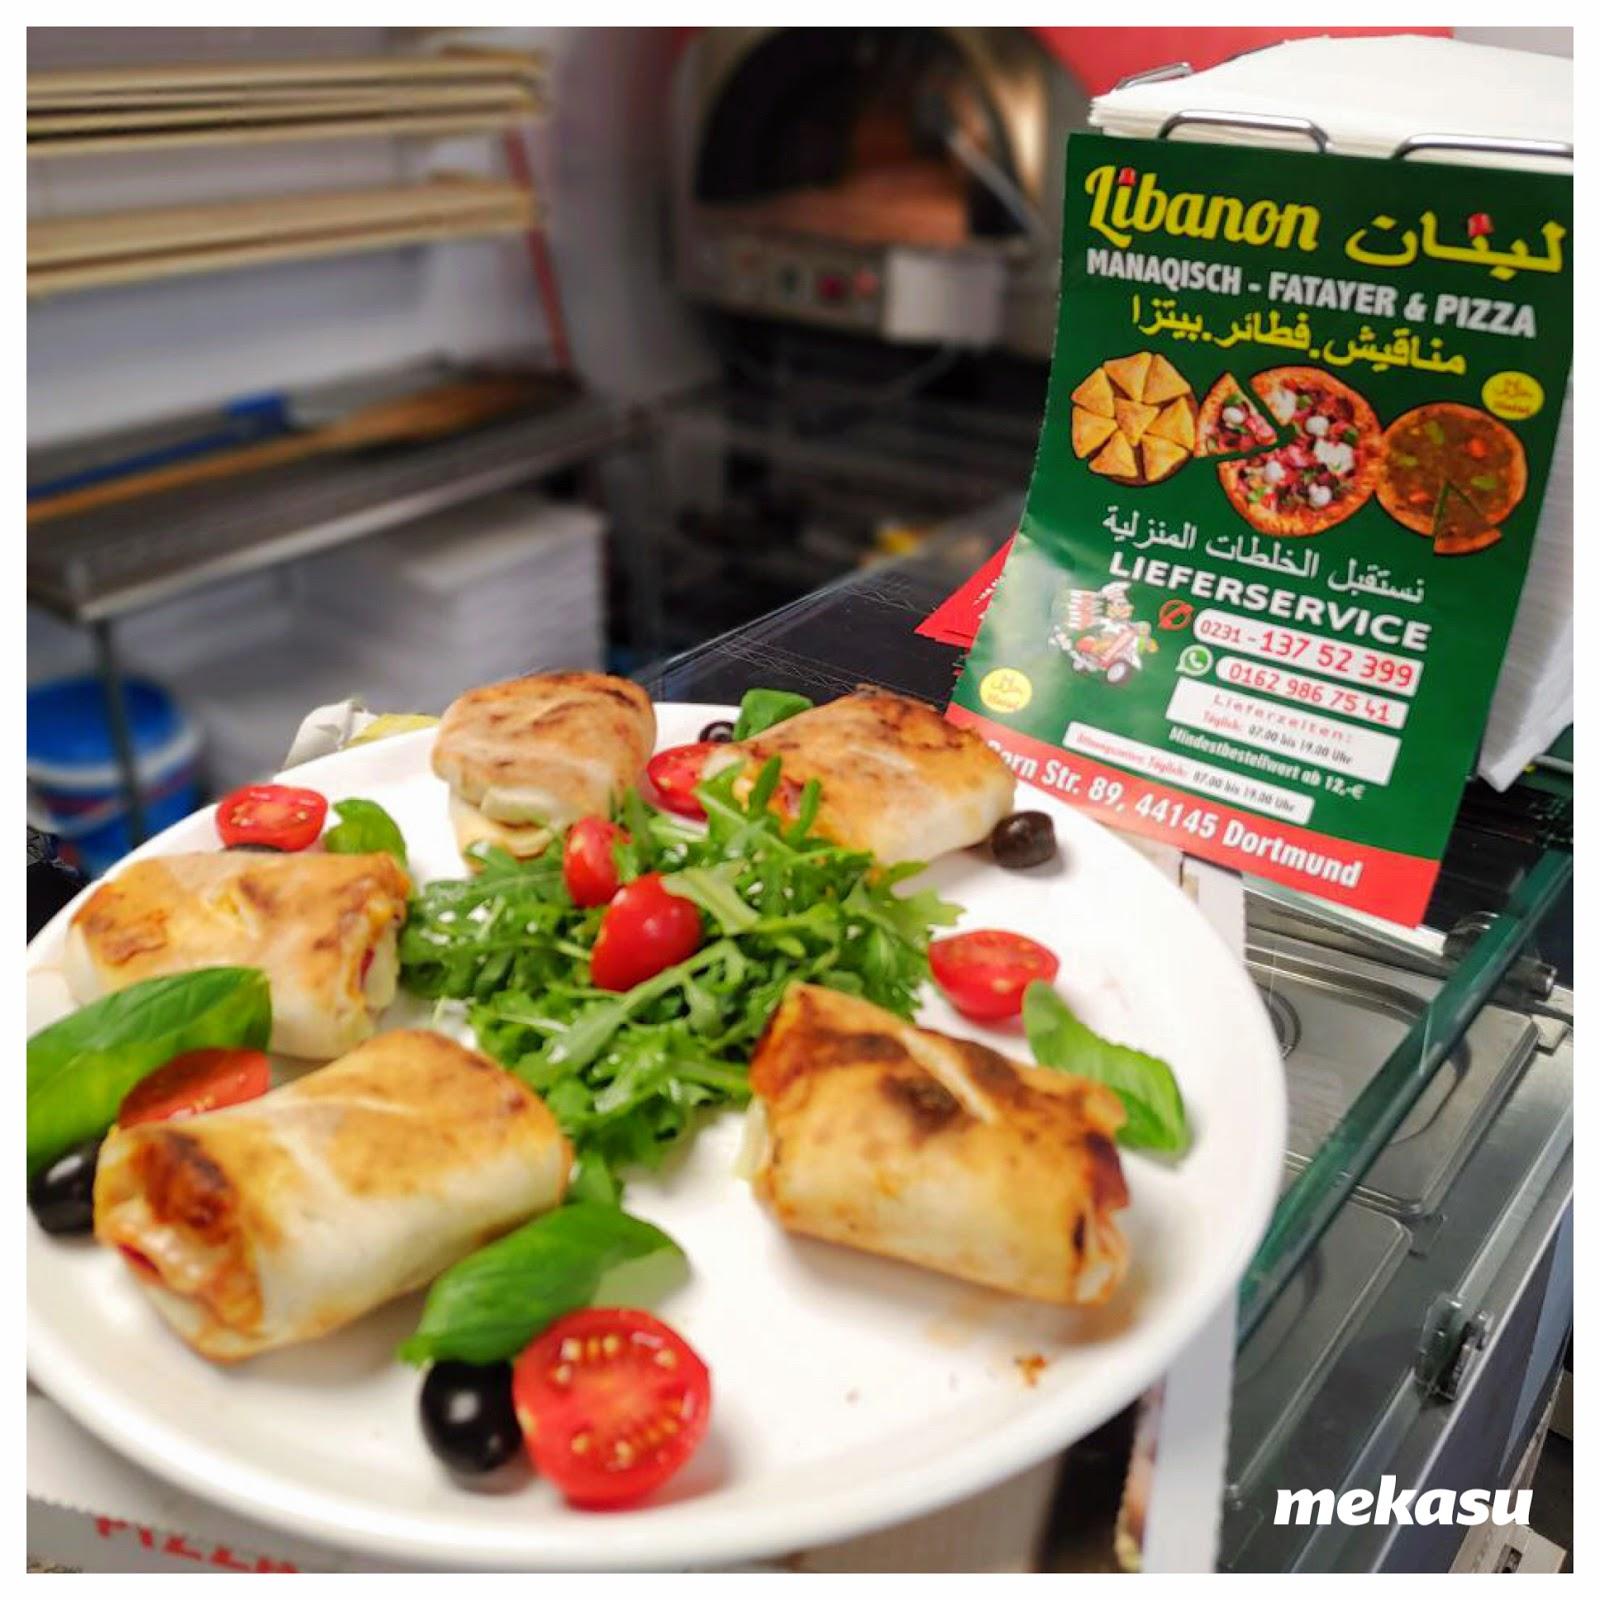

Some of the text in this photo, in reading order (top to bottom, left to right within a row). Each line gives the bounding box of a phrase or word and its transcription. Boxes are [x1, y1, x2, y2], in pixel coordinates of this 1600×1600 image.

[1085, 165, 1320, 251] Libanon
[1345, 210, 1566, 280] لبنان
[1086, 247, 1242, 296] MANAQISCH
[1268, 271, 1398, 318] FATAYER
[1403, 292, 1428, 322] &
[1434, 294, 1536, 339] PIZZA
[1109, 551, 1432, 651] LIEFERSERVICE
[1327, 558, 1425, 604] نستقبل
[1200, 619, 1241, 643] 0231
[1260, 630, 1310, 660] 137
[1317, 644, 1353, 672] 52
[1360, 655, 1414, 687] 399
[1229, 662, 1389, 722] 0162 986 75 41
[1041, 758, 1081, 795] Str.
[1088, 775, 1126, 812] 89,
[1135, 793, 1219, 840] 44145
[1221, 818, 1363, 889] Dortmund
